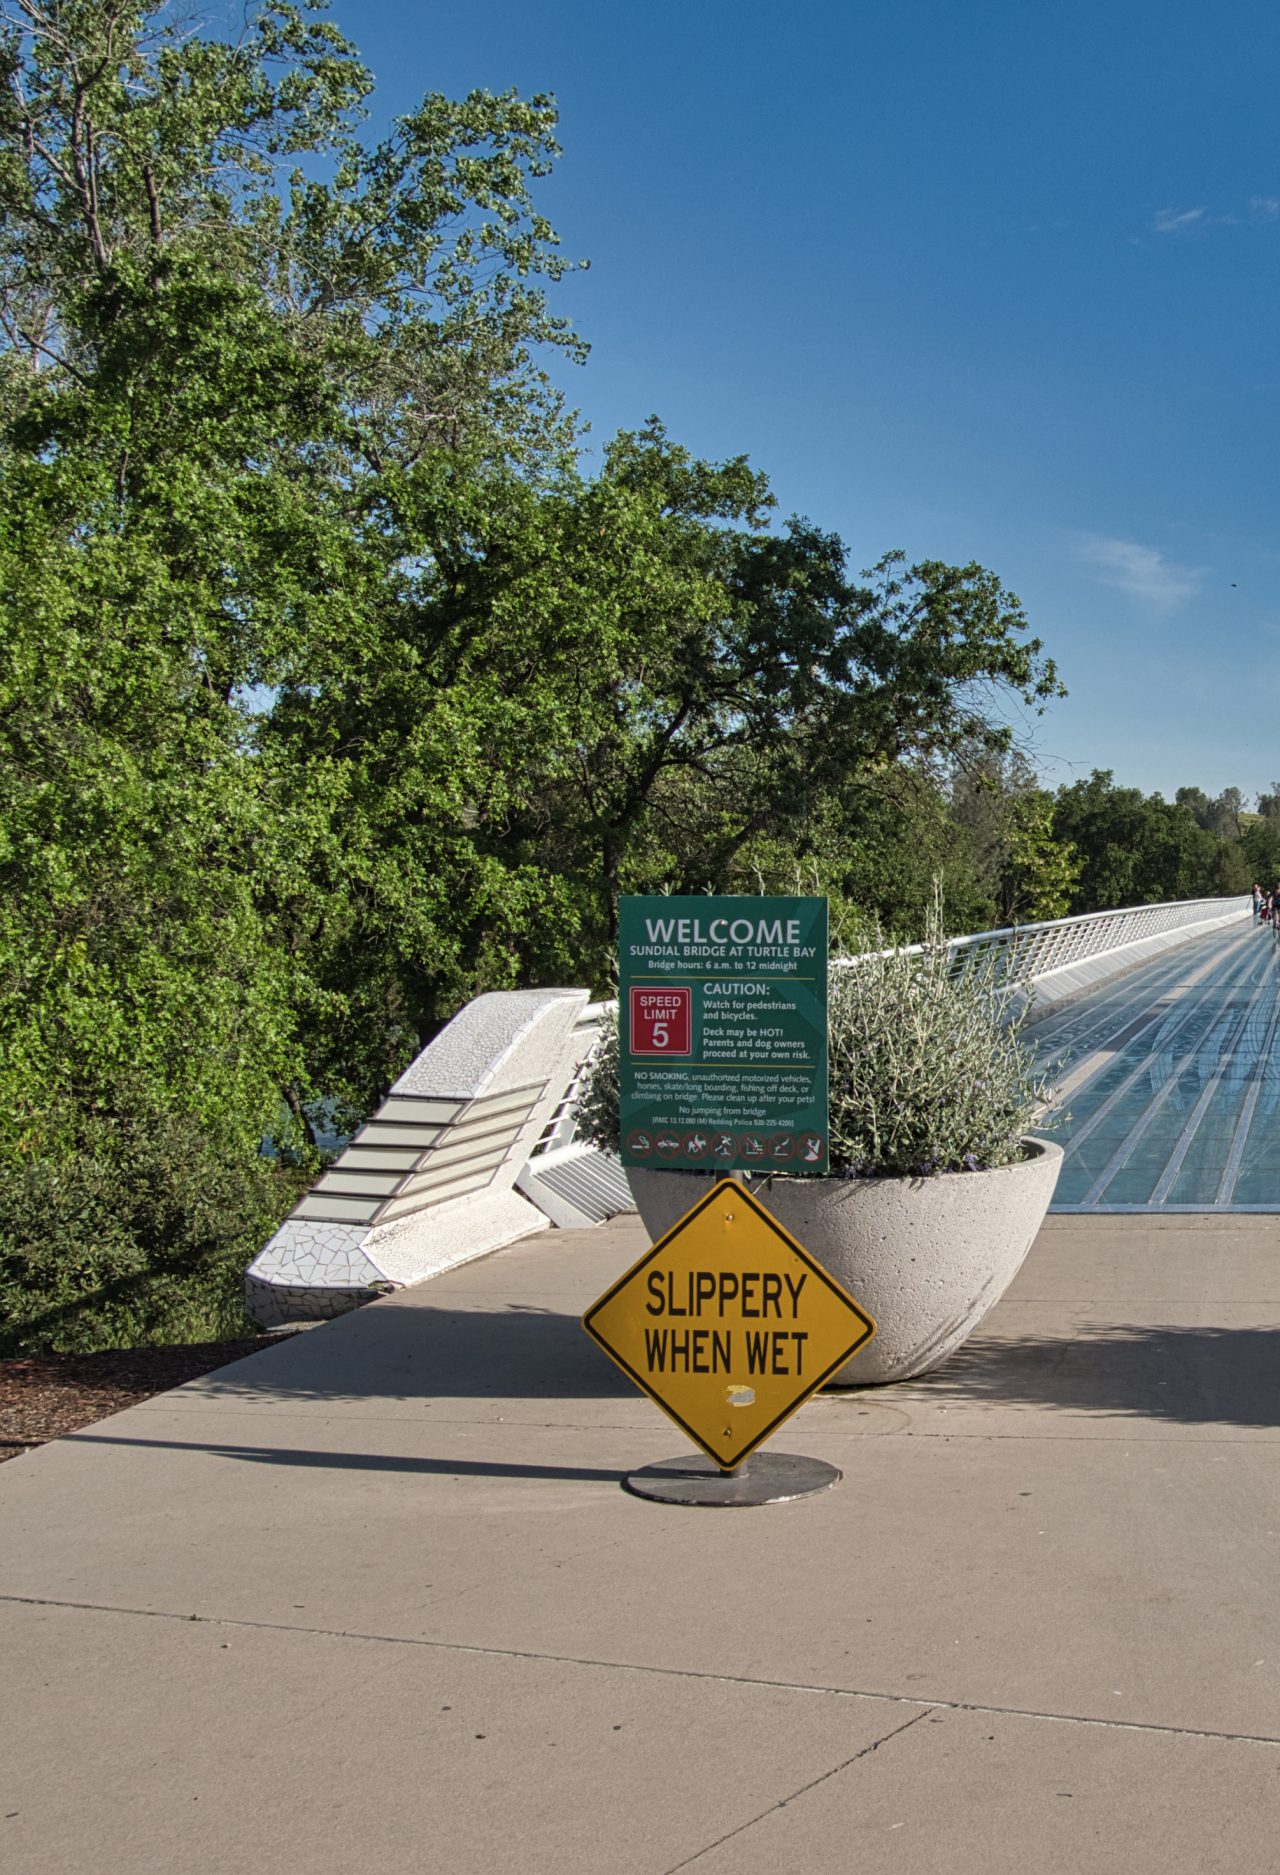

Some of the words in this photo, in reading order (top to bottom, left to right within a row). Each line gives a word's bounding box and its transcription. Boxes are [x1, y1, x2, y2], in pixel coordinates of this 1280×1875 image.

[645, 918, 801, 944] WELCOME
[630, 945, 680, 956] SUNDIAL
[684, 946, 725, 957] BRIDGE
[729, 946, 743, 957] AT
[747, 947, 789, 957] TURTLE
[793, 947, 816, 958] BAY
[648, 960, 675, 970] Bridge
[677, 960, 704, 970] hours:
[705, 961, 712, 970] 6
[714, 962, 732, 970] a.m.
[734, 962, 743, 970] to
[746, 962, 756, 970] 12
[759, 961, 798, 972] midnight
[703, 983, 770, 995] CAUTION:
[639, 996, 682, 1007] SPEED
[703, 1000, 730, 1009] Watch
[732, 1000, 745, 1009] for
[747, 1001, 796, 1011] pedestrians
[643, 1009, 677, 1020] LIMIT
[703, 1011, 719, 1020] and
[721, 1011, 758, 1022] bicycles.
[652, 1022, 669, 1047] 5
[703, 1027, 724, 1036] Deck
[726, 1029, 744, 1039] may
[747, 1028, 758, 1037] be
[760, 1028, 784, 1037] HOT!
[703, 1038, 734, 1047] Parents
[737, 1039, 753, 1048] and
[755, 1039, 772, 1050] dog
[703, 1050, 736, 1060] proceed
[739, 1050, 747, 1058] at
[749, 1051, 769, 1061] your
[771, 1051, 790, 1059] own
[792, 1050, 811, 1060] risk.
[634, 1072, 648, 1080] NO
[649, 1072, 690, 1081] SMOKING,
[692, 1073, 740, 1082] unauthorized
[742, 1074, 779, 1083] motorized
[740, 1083, 766, 1094] fishing
[766, 1084, 778, 1093] off
[631, 1091, 662, 1102] climbing
[701, 1093, 725, 1102] Please
[726, 1094, 746, 1102] clean
[747, 1095, 758, 1104] up
[759, 1094, 777, 1103] after
[778, 1096, 796, 1105] your
[679, 1106, 691, 1114] No
[691, 1107, 722, 1117] jumping
[723, 1107, 741, 1116] from
[743, 1107, 767, 1117] bridge
[645, 1270, 808, 1319] SLIPPERY
[644, 1328, 732, 1374] WHEN
[745, 1331, 809, 1376] WET
